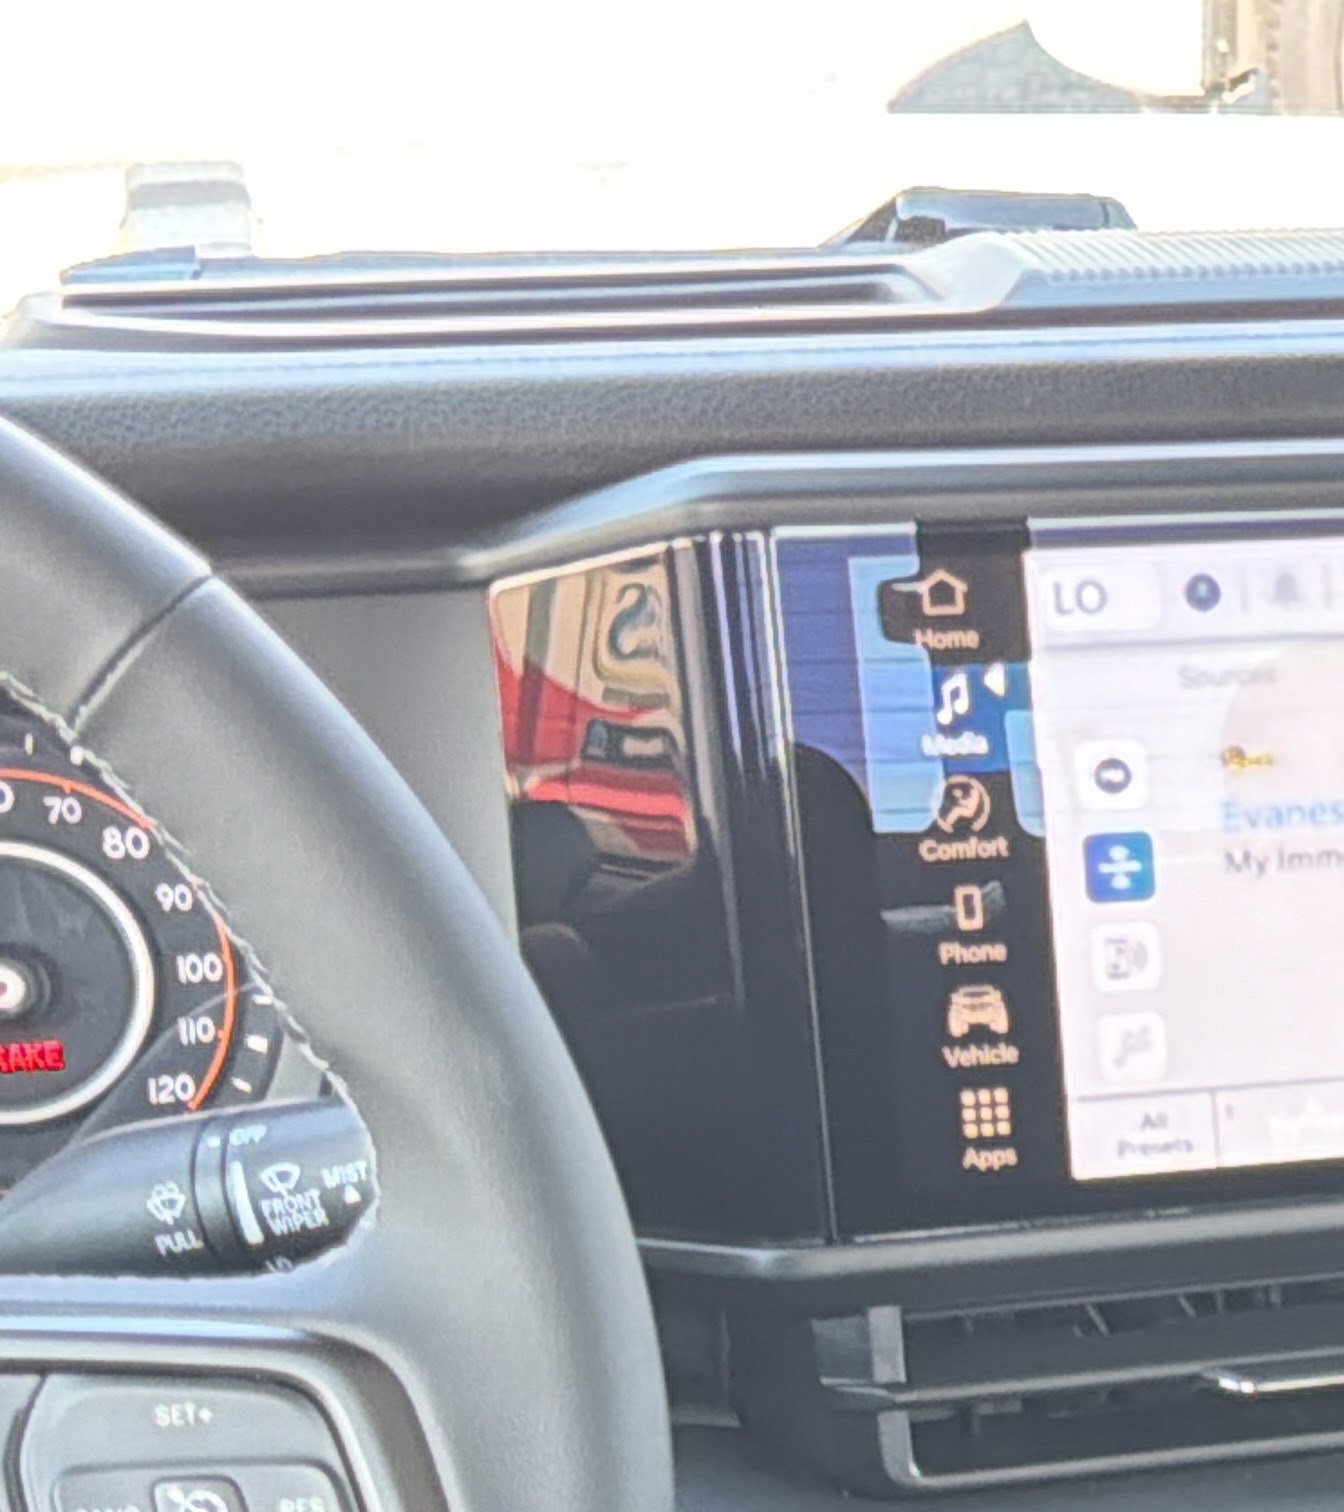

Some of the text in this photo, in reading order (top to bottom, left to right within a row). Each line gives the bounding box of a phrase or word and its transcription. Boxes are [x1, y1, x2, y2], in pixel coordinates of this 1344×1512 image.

[1053, 580, 1107, 616] LO
[914, 627, 980, 650] Home
[43, 796, 83, 825] 70
[103, 826, 150, 860] 80
[918, 836, 1009, 862] Comfort
[1223, 849, 1268, 880] My
[155, 883, 193, 912] 90
[176, 953, 223, 983] 100
[938, 941, 1007, 967] Phone
[179, 1015, 215, 1045] 110
[941, 1043, 1019, 1070] Vehicle
[147, 1073, 196, 1102] 120
[962, 1147, 1017, 1173] Apps
[155, 1230, 204, 1256] PULL
[154, 1403, 214, 1427] SET+
